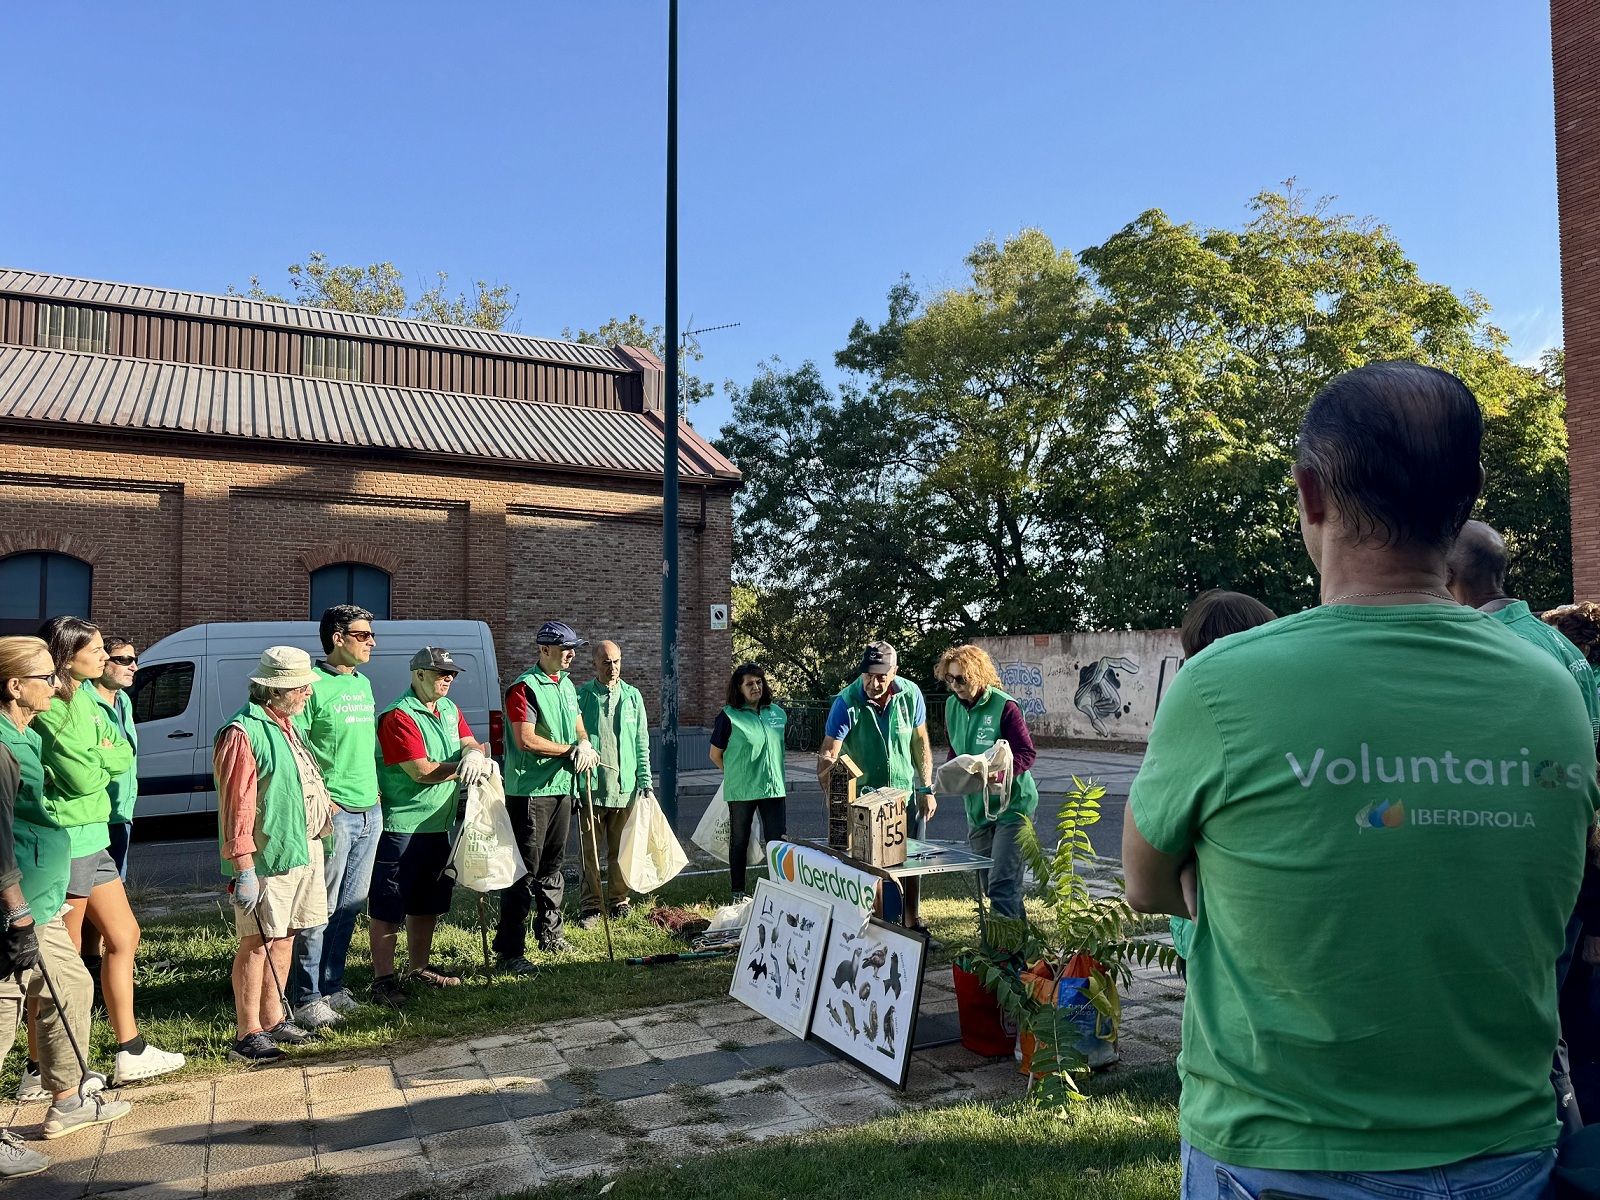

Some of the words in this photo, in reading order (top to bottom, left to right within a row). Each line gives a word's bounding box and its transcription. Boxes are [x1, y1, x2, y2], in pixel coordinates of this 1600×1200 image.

[1285, 742, 1584, 789] Voluntarios
[884, 820, 904, 847] 55
[1410, 807, 1536, 828] IBERDROLA
[797, 853, 875, 911] Iberdrola
